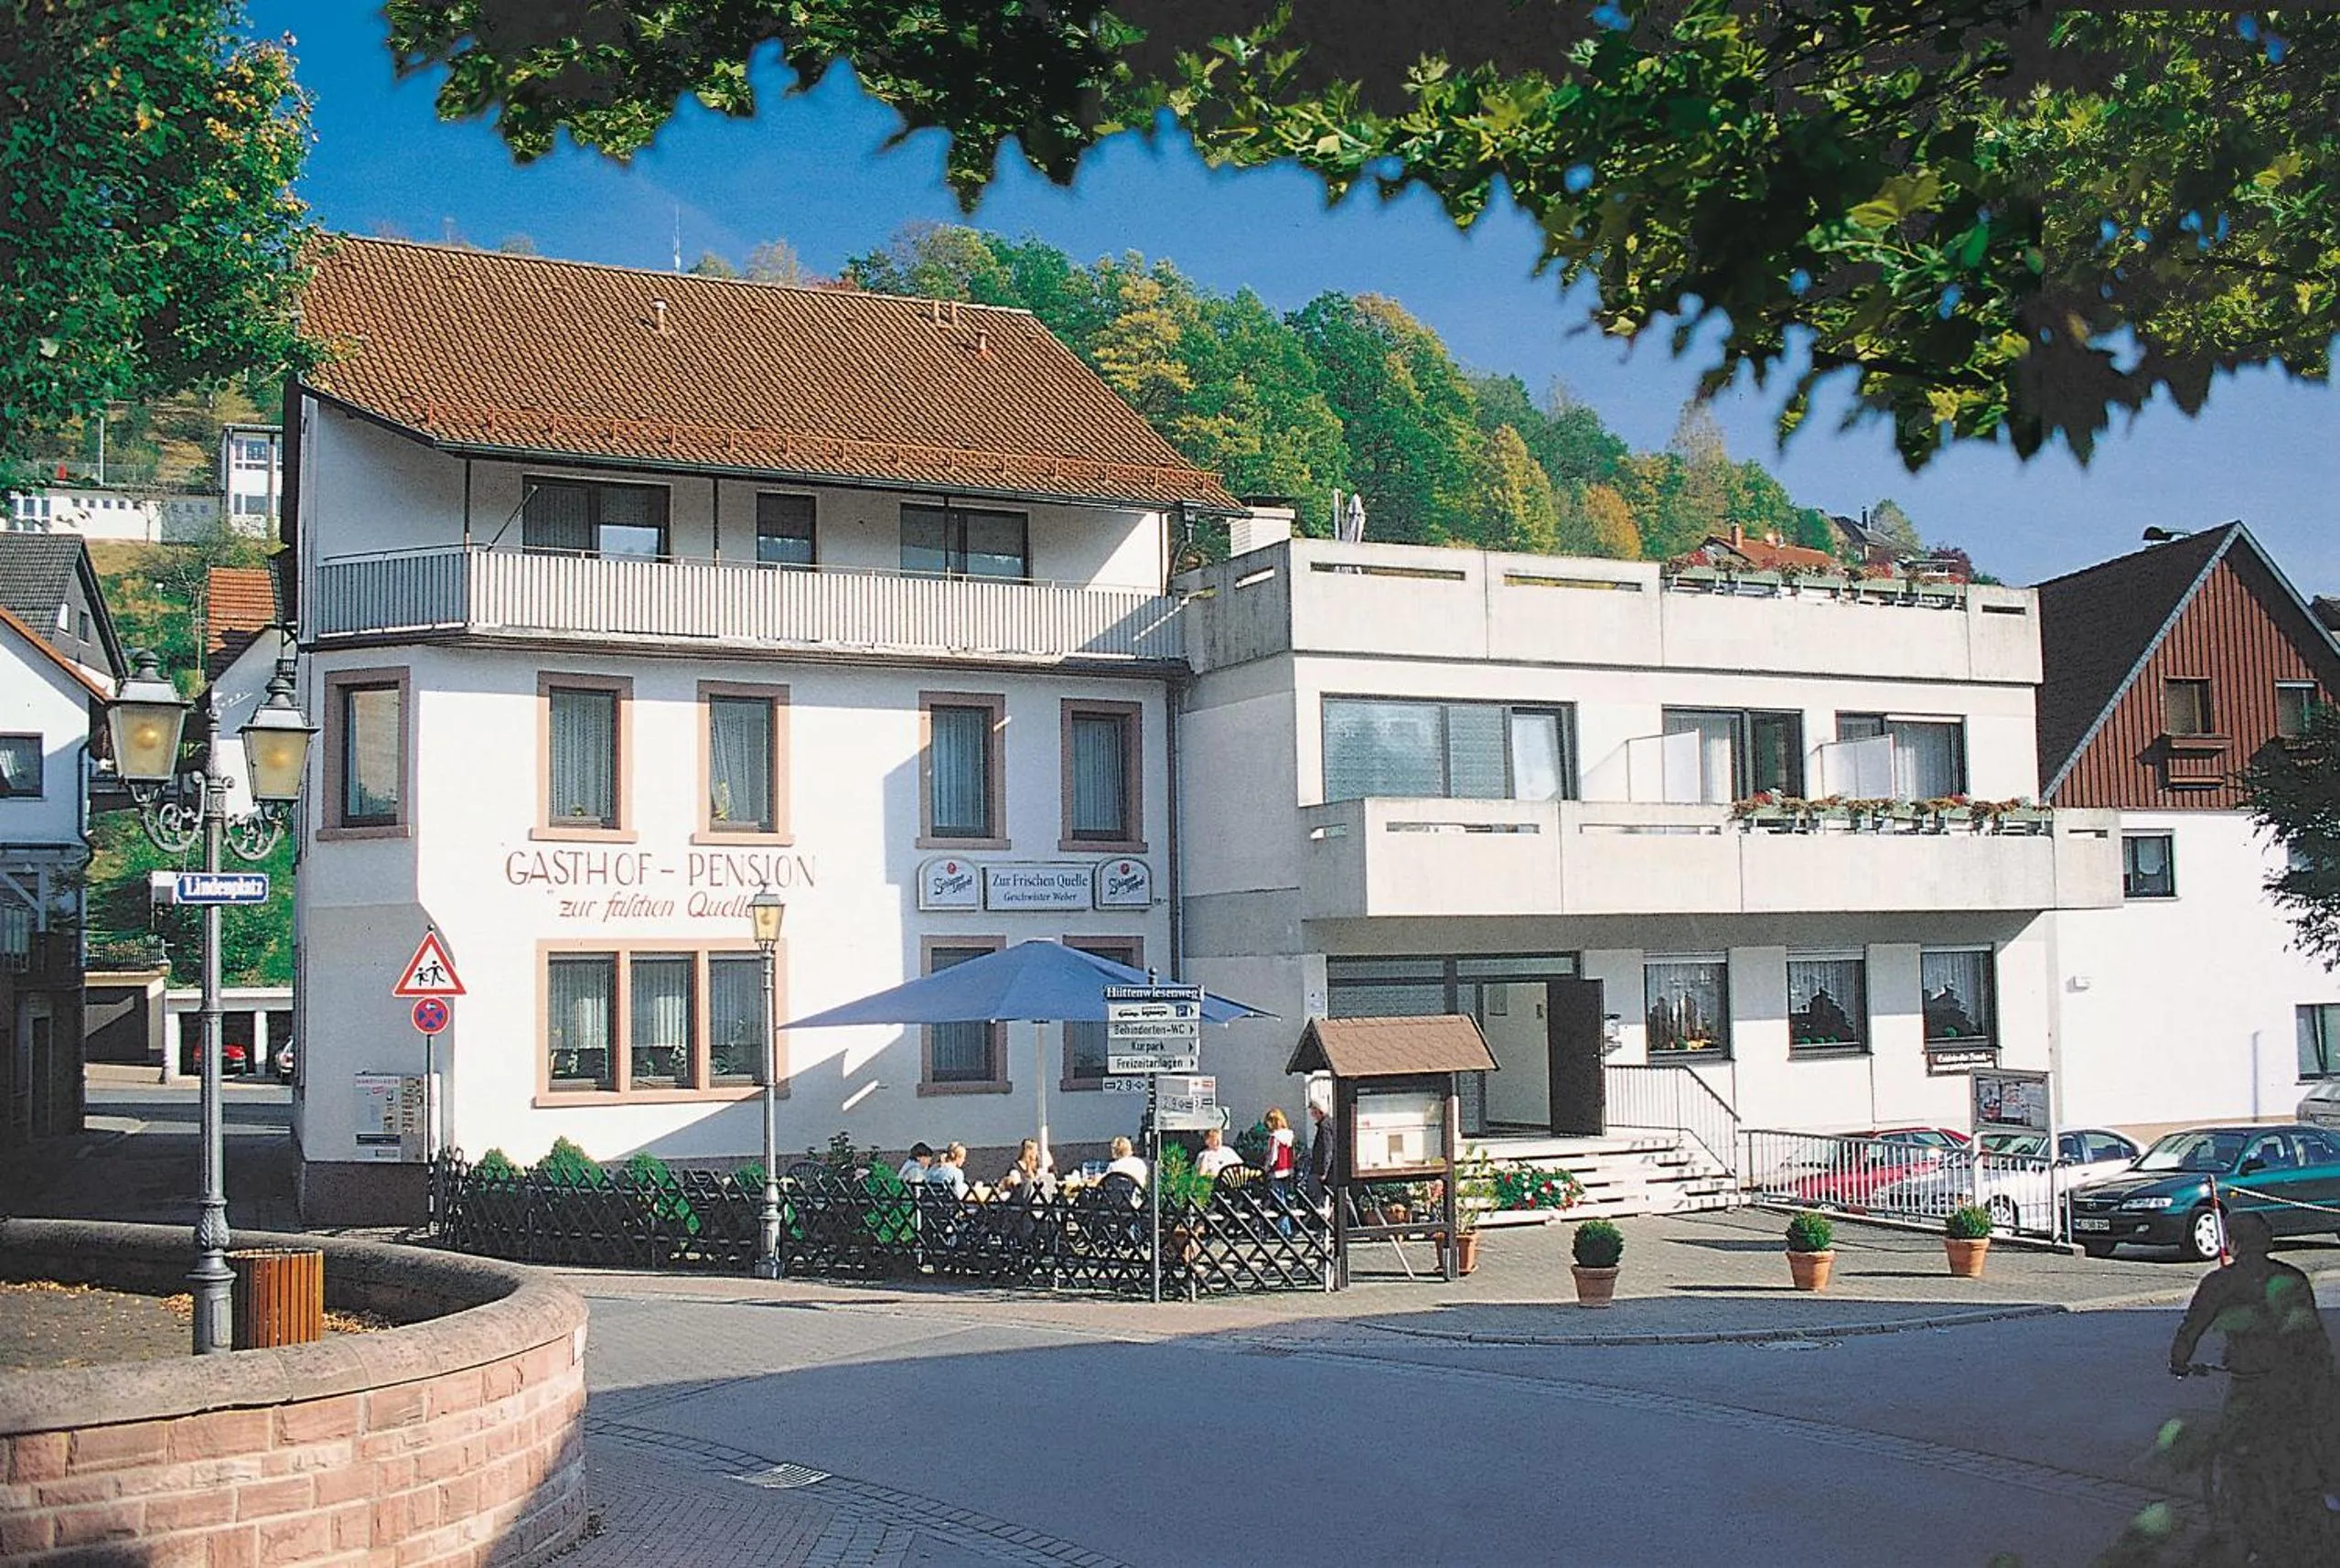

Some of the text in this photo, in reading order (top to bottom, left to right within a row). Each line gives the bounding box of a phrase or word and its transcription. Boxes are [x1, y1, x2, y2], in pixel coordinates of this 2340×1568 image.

[505, 851, 653, 886] GASTHOF
[688, 852, 817, 887] PENSION
[993, 873, 1089, 888] Zur Frischen Quelle
[1106, 987, 1199, 1000] Hüttenwiesenweg
[1114, 1024, 1186, 1036] Behinderten-WC
[1132, 1040, 1165, 1053] Kurpark
[1116, 1057, 1184, 1070] Freizeitanlagen
